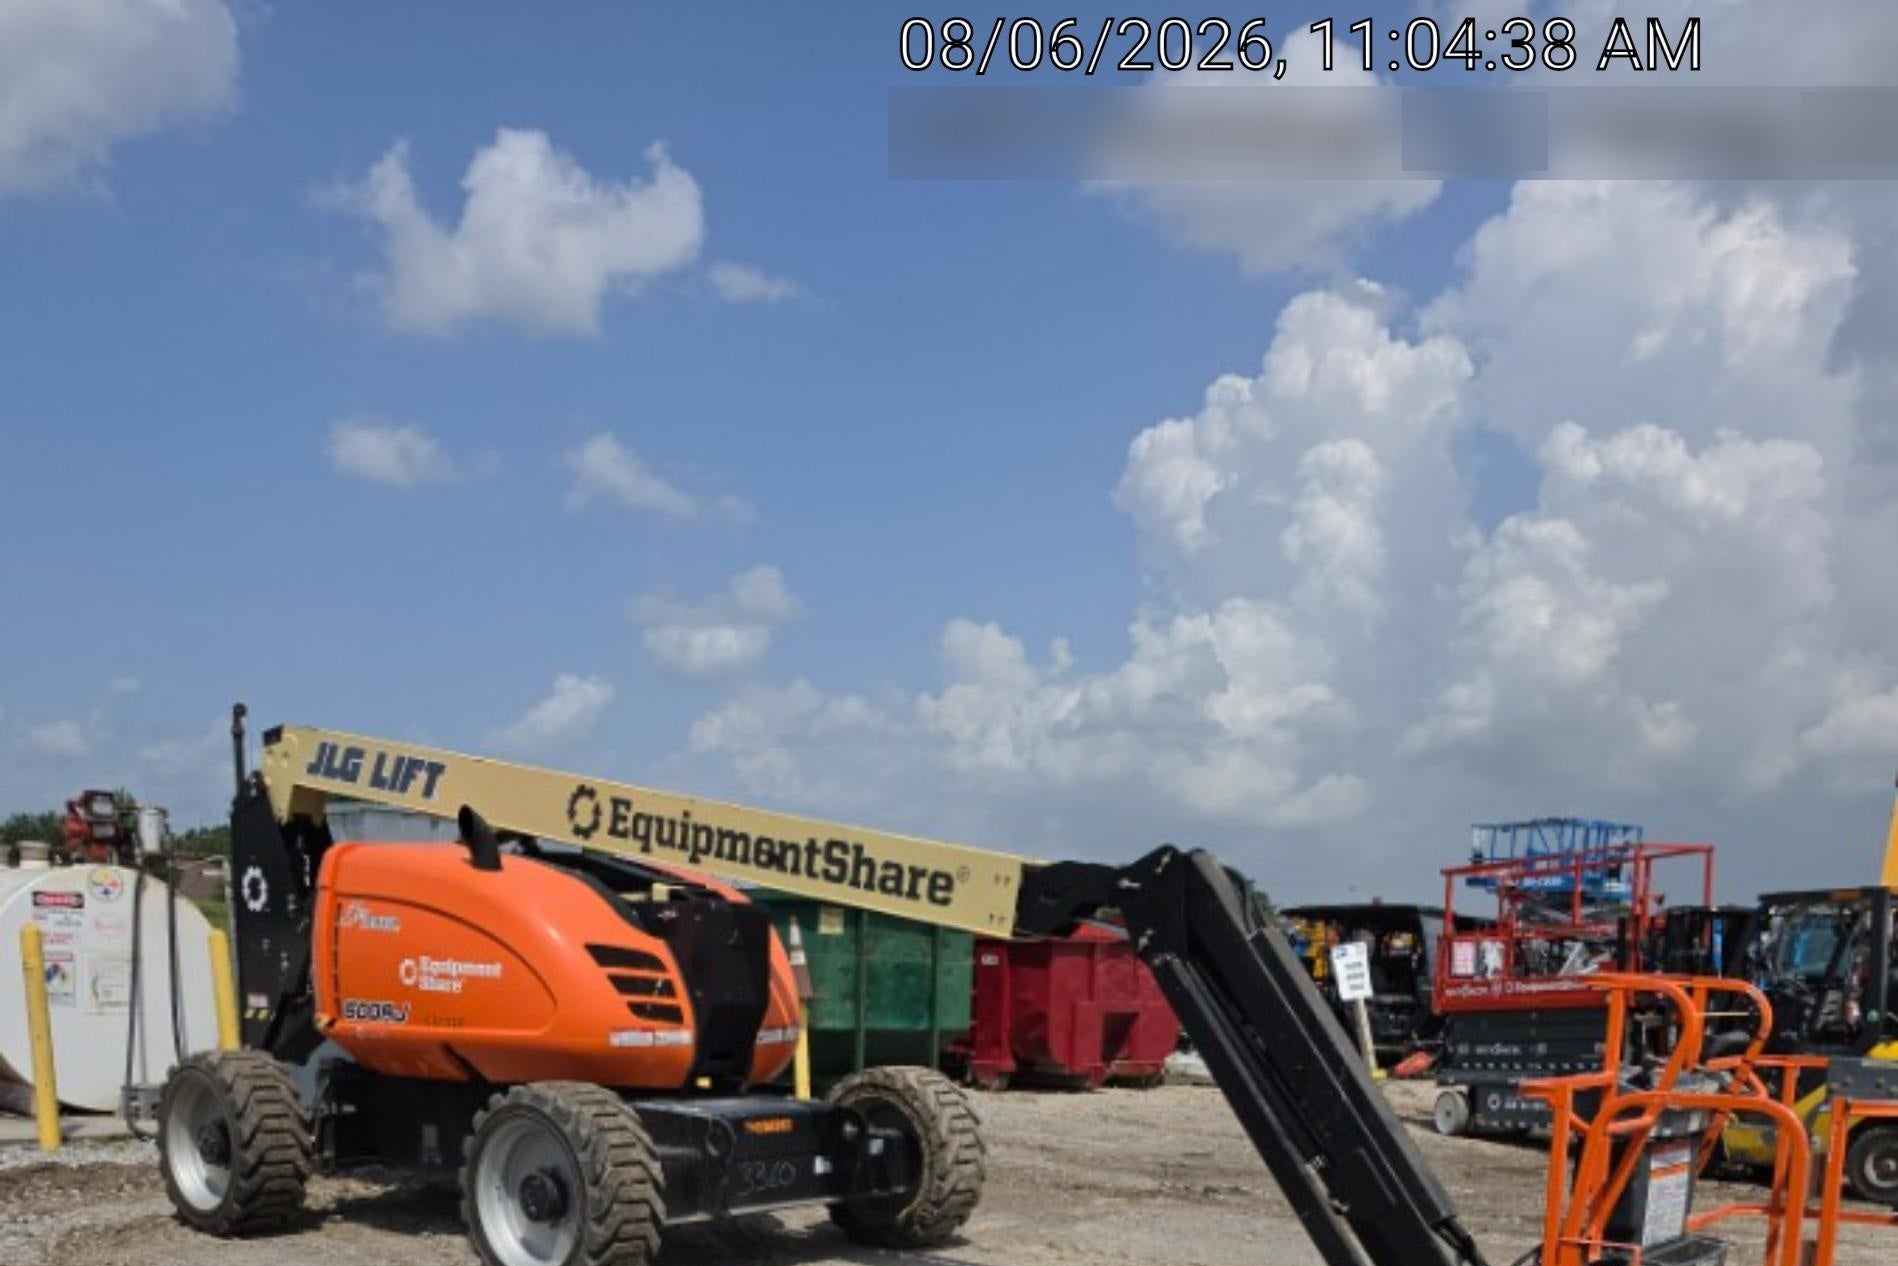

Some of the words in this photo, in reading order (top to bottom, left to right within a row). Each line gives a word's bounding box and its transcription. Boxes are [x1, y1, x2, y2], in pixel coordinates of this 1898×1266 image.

[306, 742, 366, 783] JLG
[369, 752, 446, 799] LIFT
[607, 797, 954, 906] EquipmentShare
